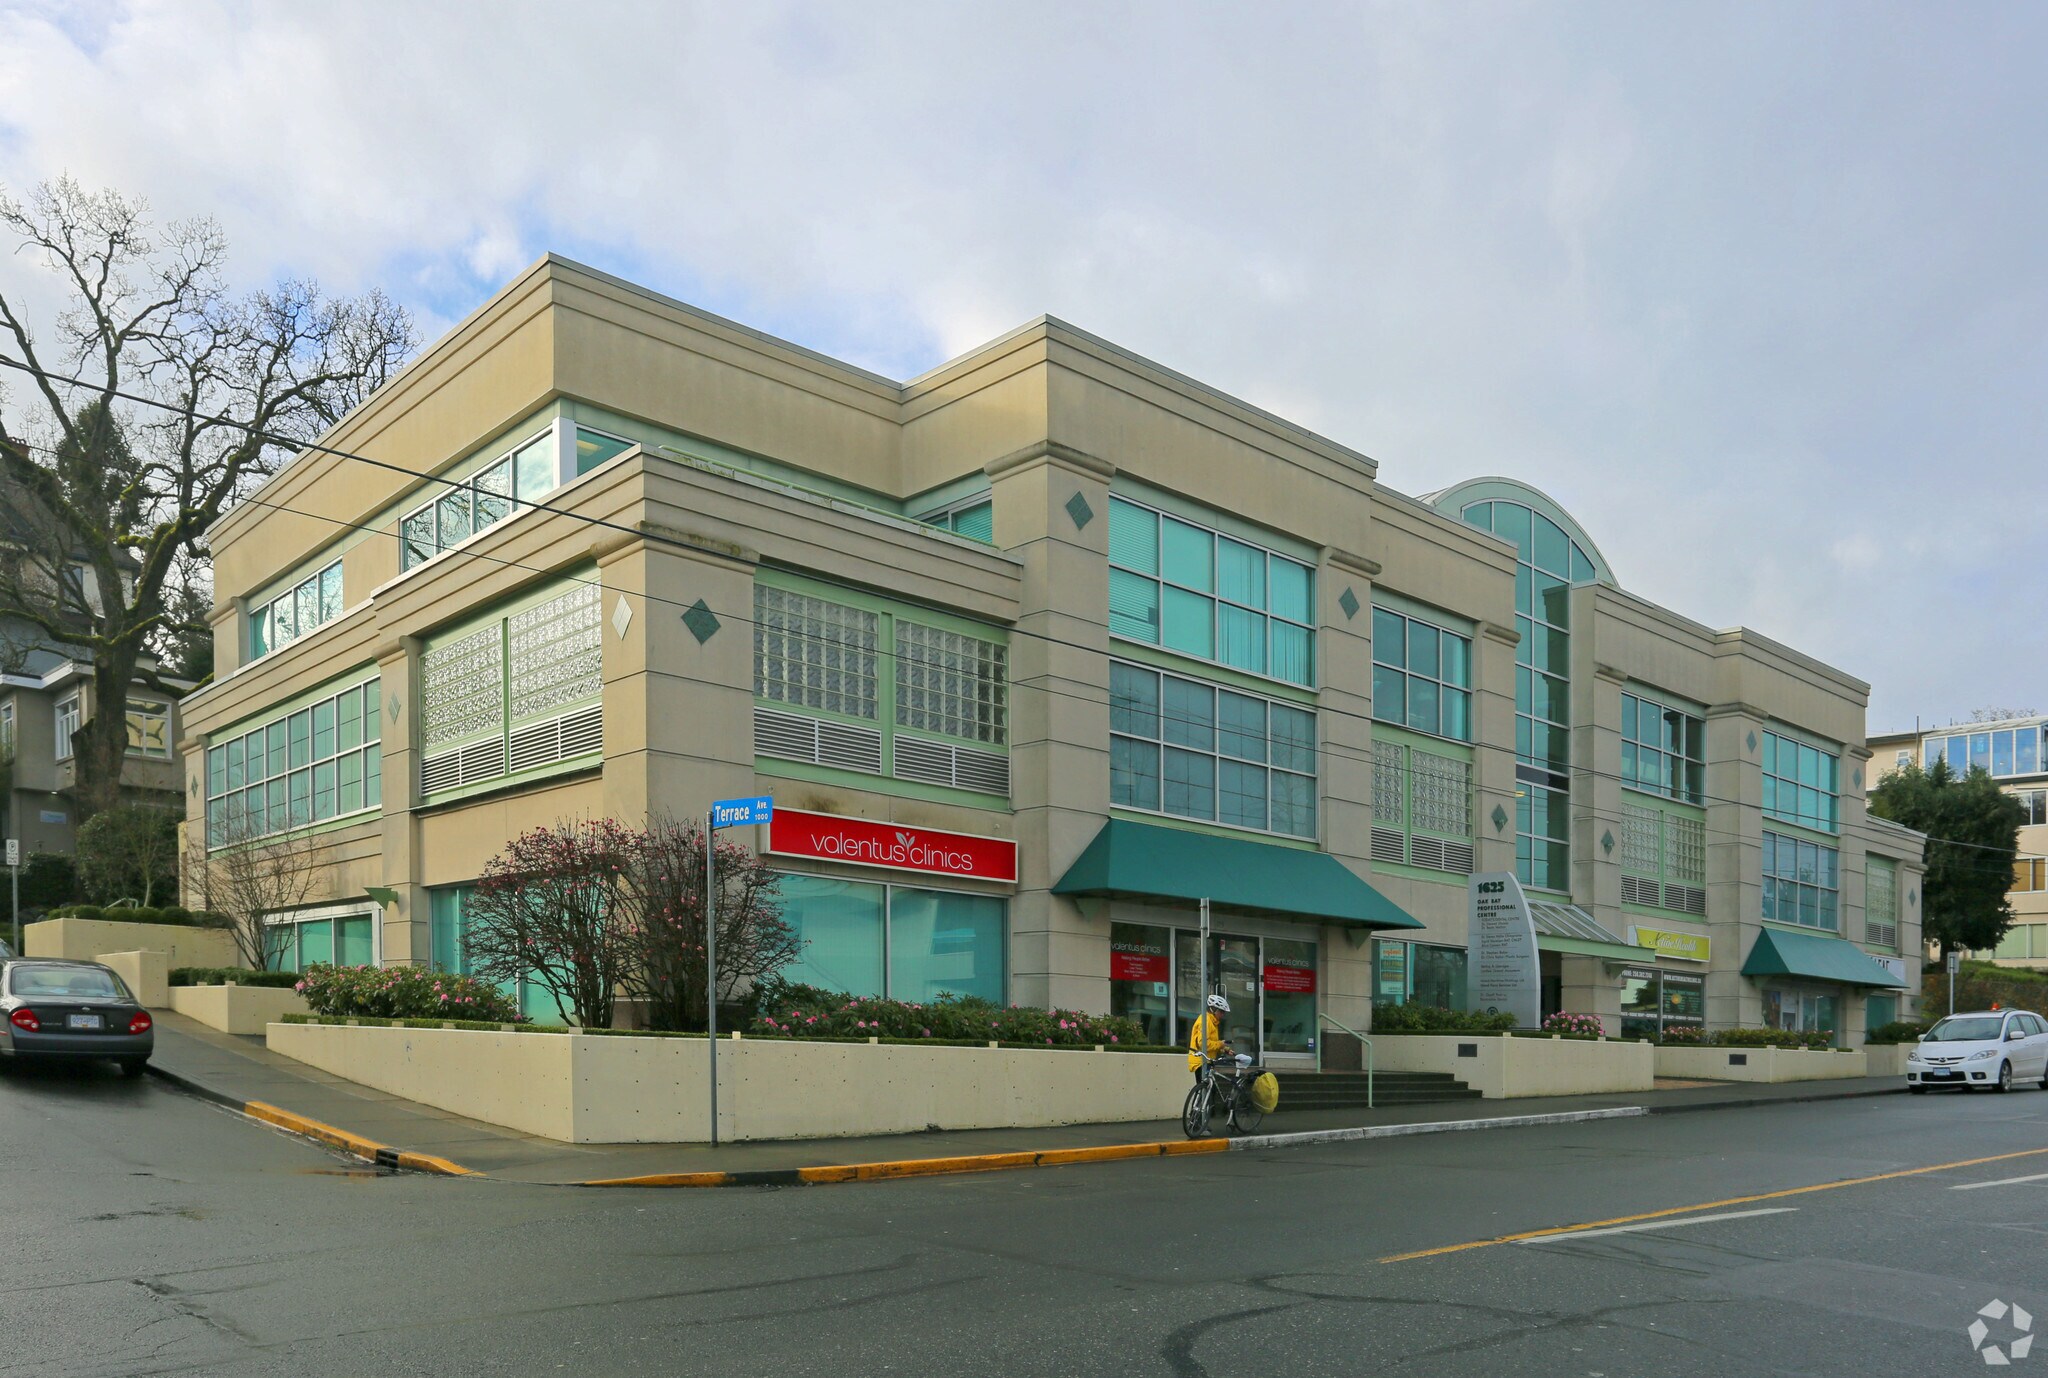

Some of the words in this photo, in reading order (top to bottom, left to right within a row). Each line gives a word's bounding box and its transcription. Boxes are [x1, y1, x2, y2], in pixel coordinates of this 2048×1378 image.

[715, 803, 750, 823] Terrace
[755, 813, 769, 821] 1000
[810, 832, 905, 863] valentus
[909, 842, 973, 871] clinics
[1477, 881, 1505, 894] 1625
[1477, 904, 1516, 912] PROFESSIONAL
